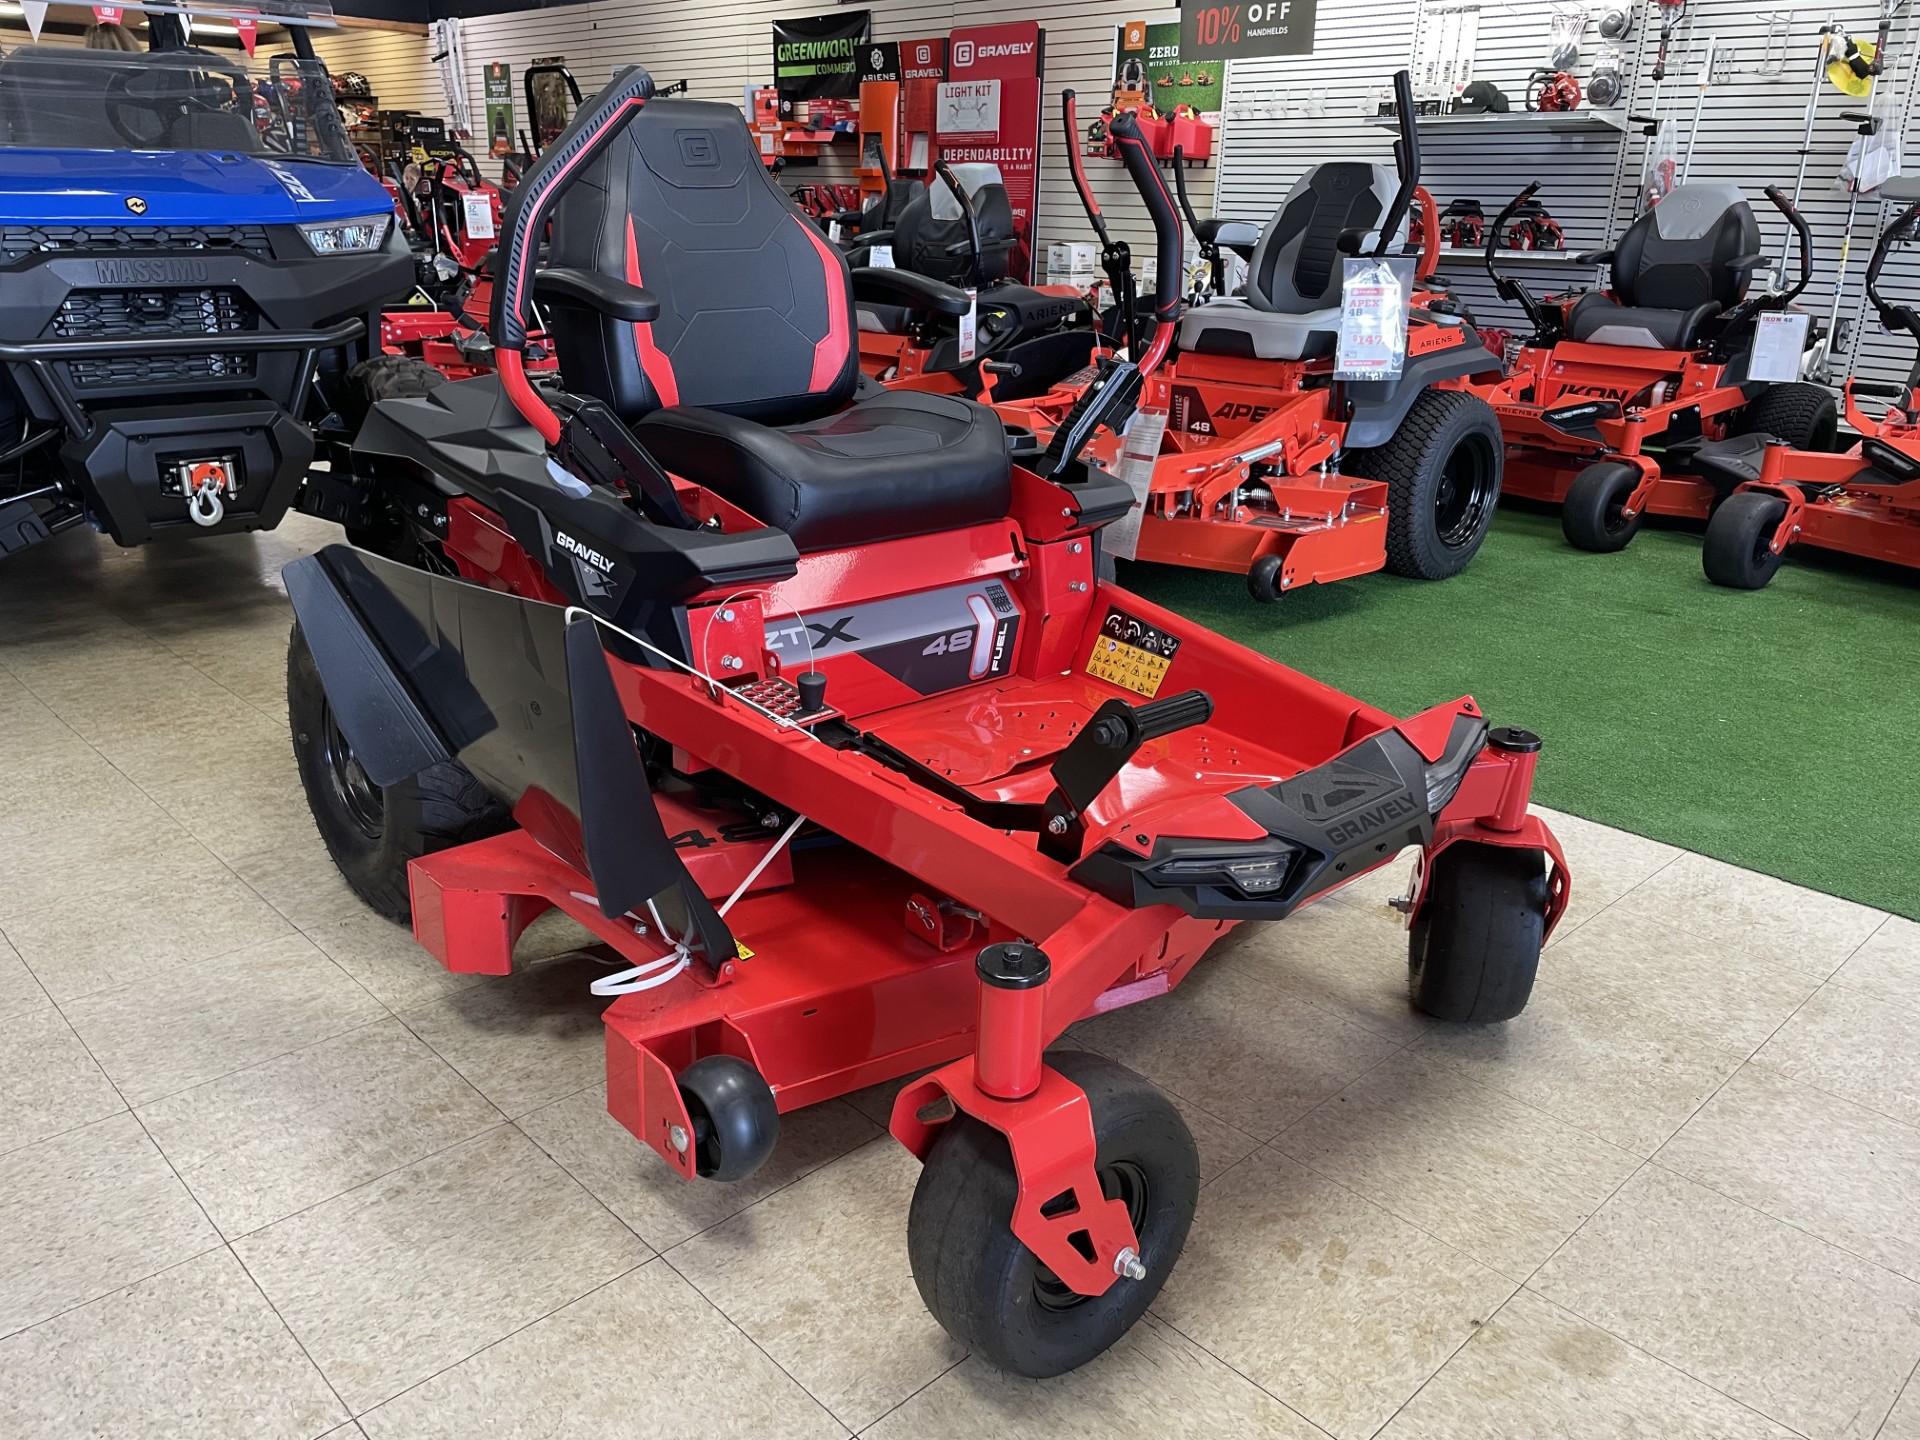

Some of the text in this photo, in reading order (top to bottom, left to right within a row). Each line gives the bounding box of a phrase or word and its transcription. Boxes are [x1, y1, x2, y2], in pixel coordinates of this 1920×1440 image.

[1196, 2, 1291, 45] 10% OFF
[1247, 26, 1289, 37] HANDHELDS
[977, 42, 1034, 58] GRAVELY
[1149, 45, 1179, 59] ZERO
[861, 72, 896, 82] ARIENS
[945, 84, 992, 98] LIGHT KIT
[417, 126, 440, 134] HELMET
[943, 147, 1033, 161] DEPENDABILITY
[96, 259, 209, 284] MASSIMO
[1026, 301, 1076, 321] ARIENS
[1348, 308, 1363, 317] 48
[1420, 335, 1453, 349] ARIENS
[1211, 402, 1280, 424] APE
[1494, 406, 1534, 417] ARIENS
[1190, 421, 1211, 433] 48
[556, 530, 616, 574] GRAVELY
[922, 629, 973, 656] 48
[991, 622, 1008, 671] FUEL
[1325, 791, 1418, 846] GRAVELY
